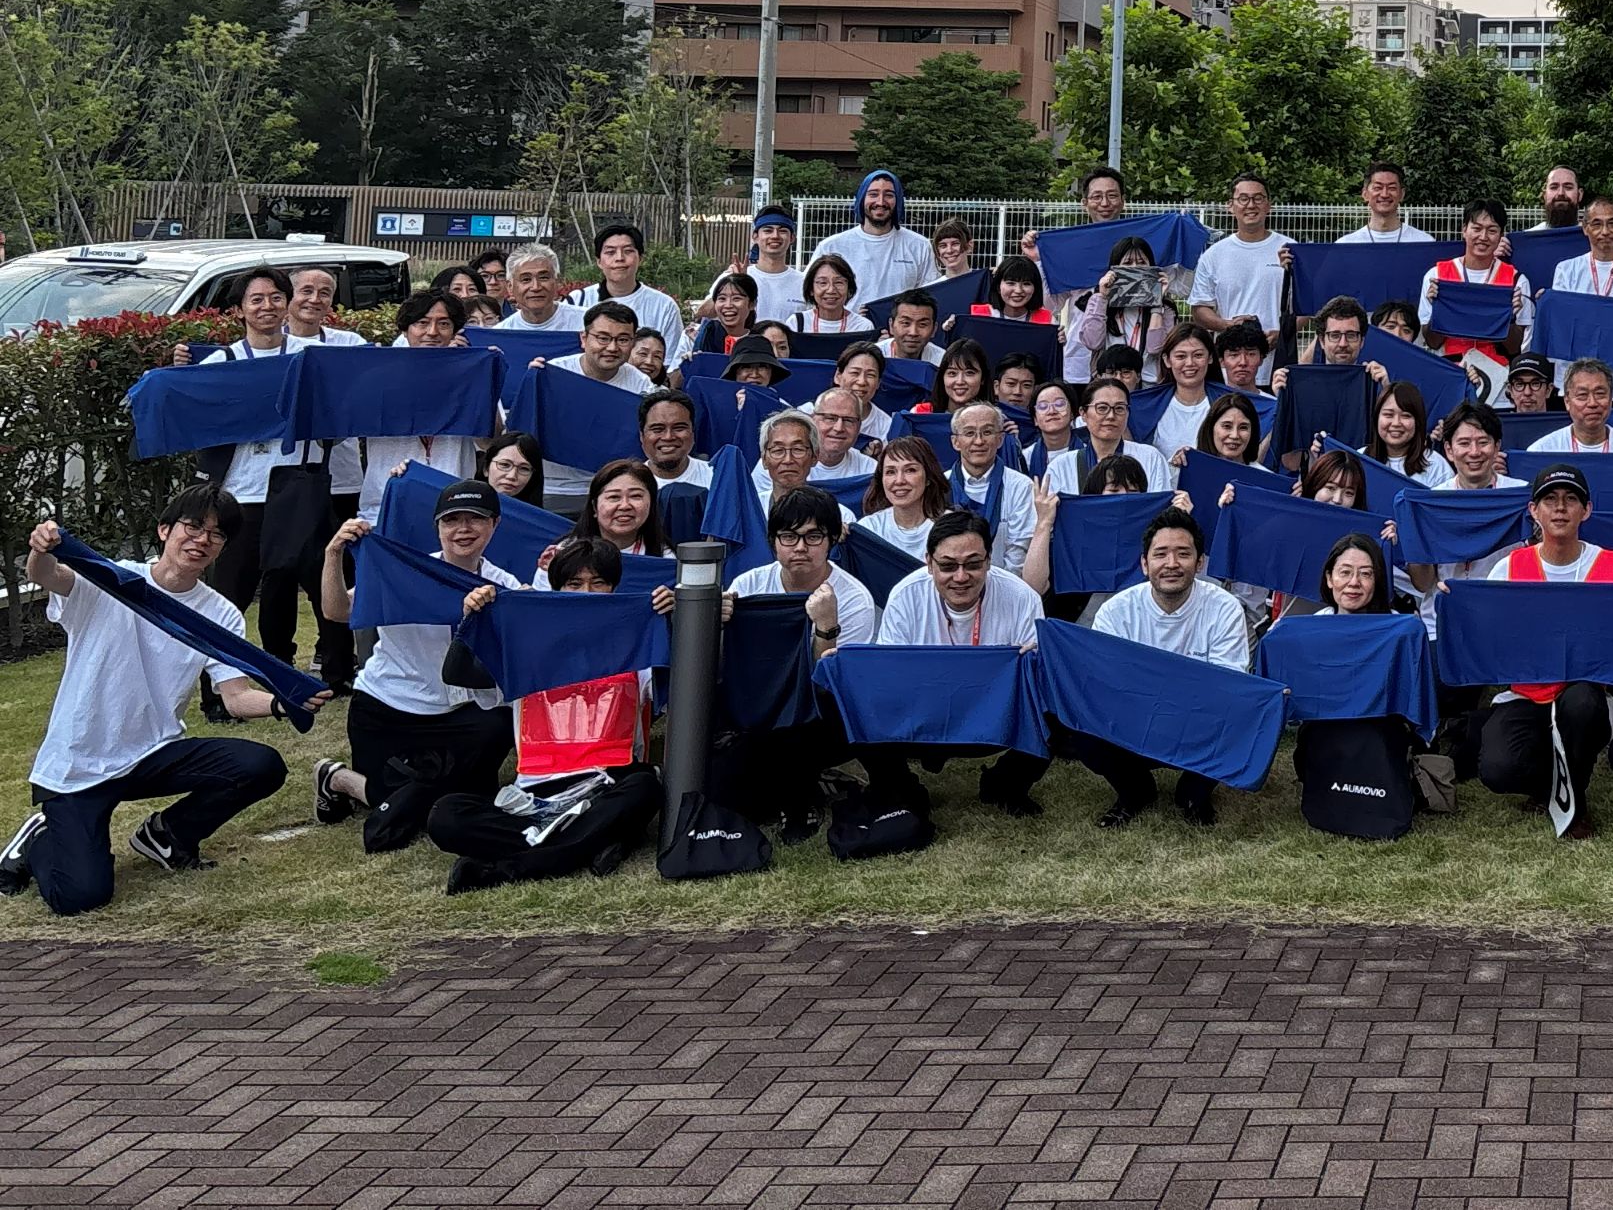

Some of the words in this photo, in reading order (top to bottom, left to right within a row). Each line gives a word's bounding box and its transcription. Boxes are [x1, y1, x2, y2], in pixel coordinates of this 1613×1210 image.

[725, 214, 753, 223] TOWE
[1342, 783, 1385, 797] AUMOVIO
[696, 829, 741, 840] AUMOVIO
